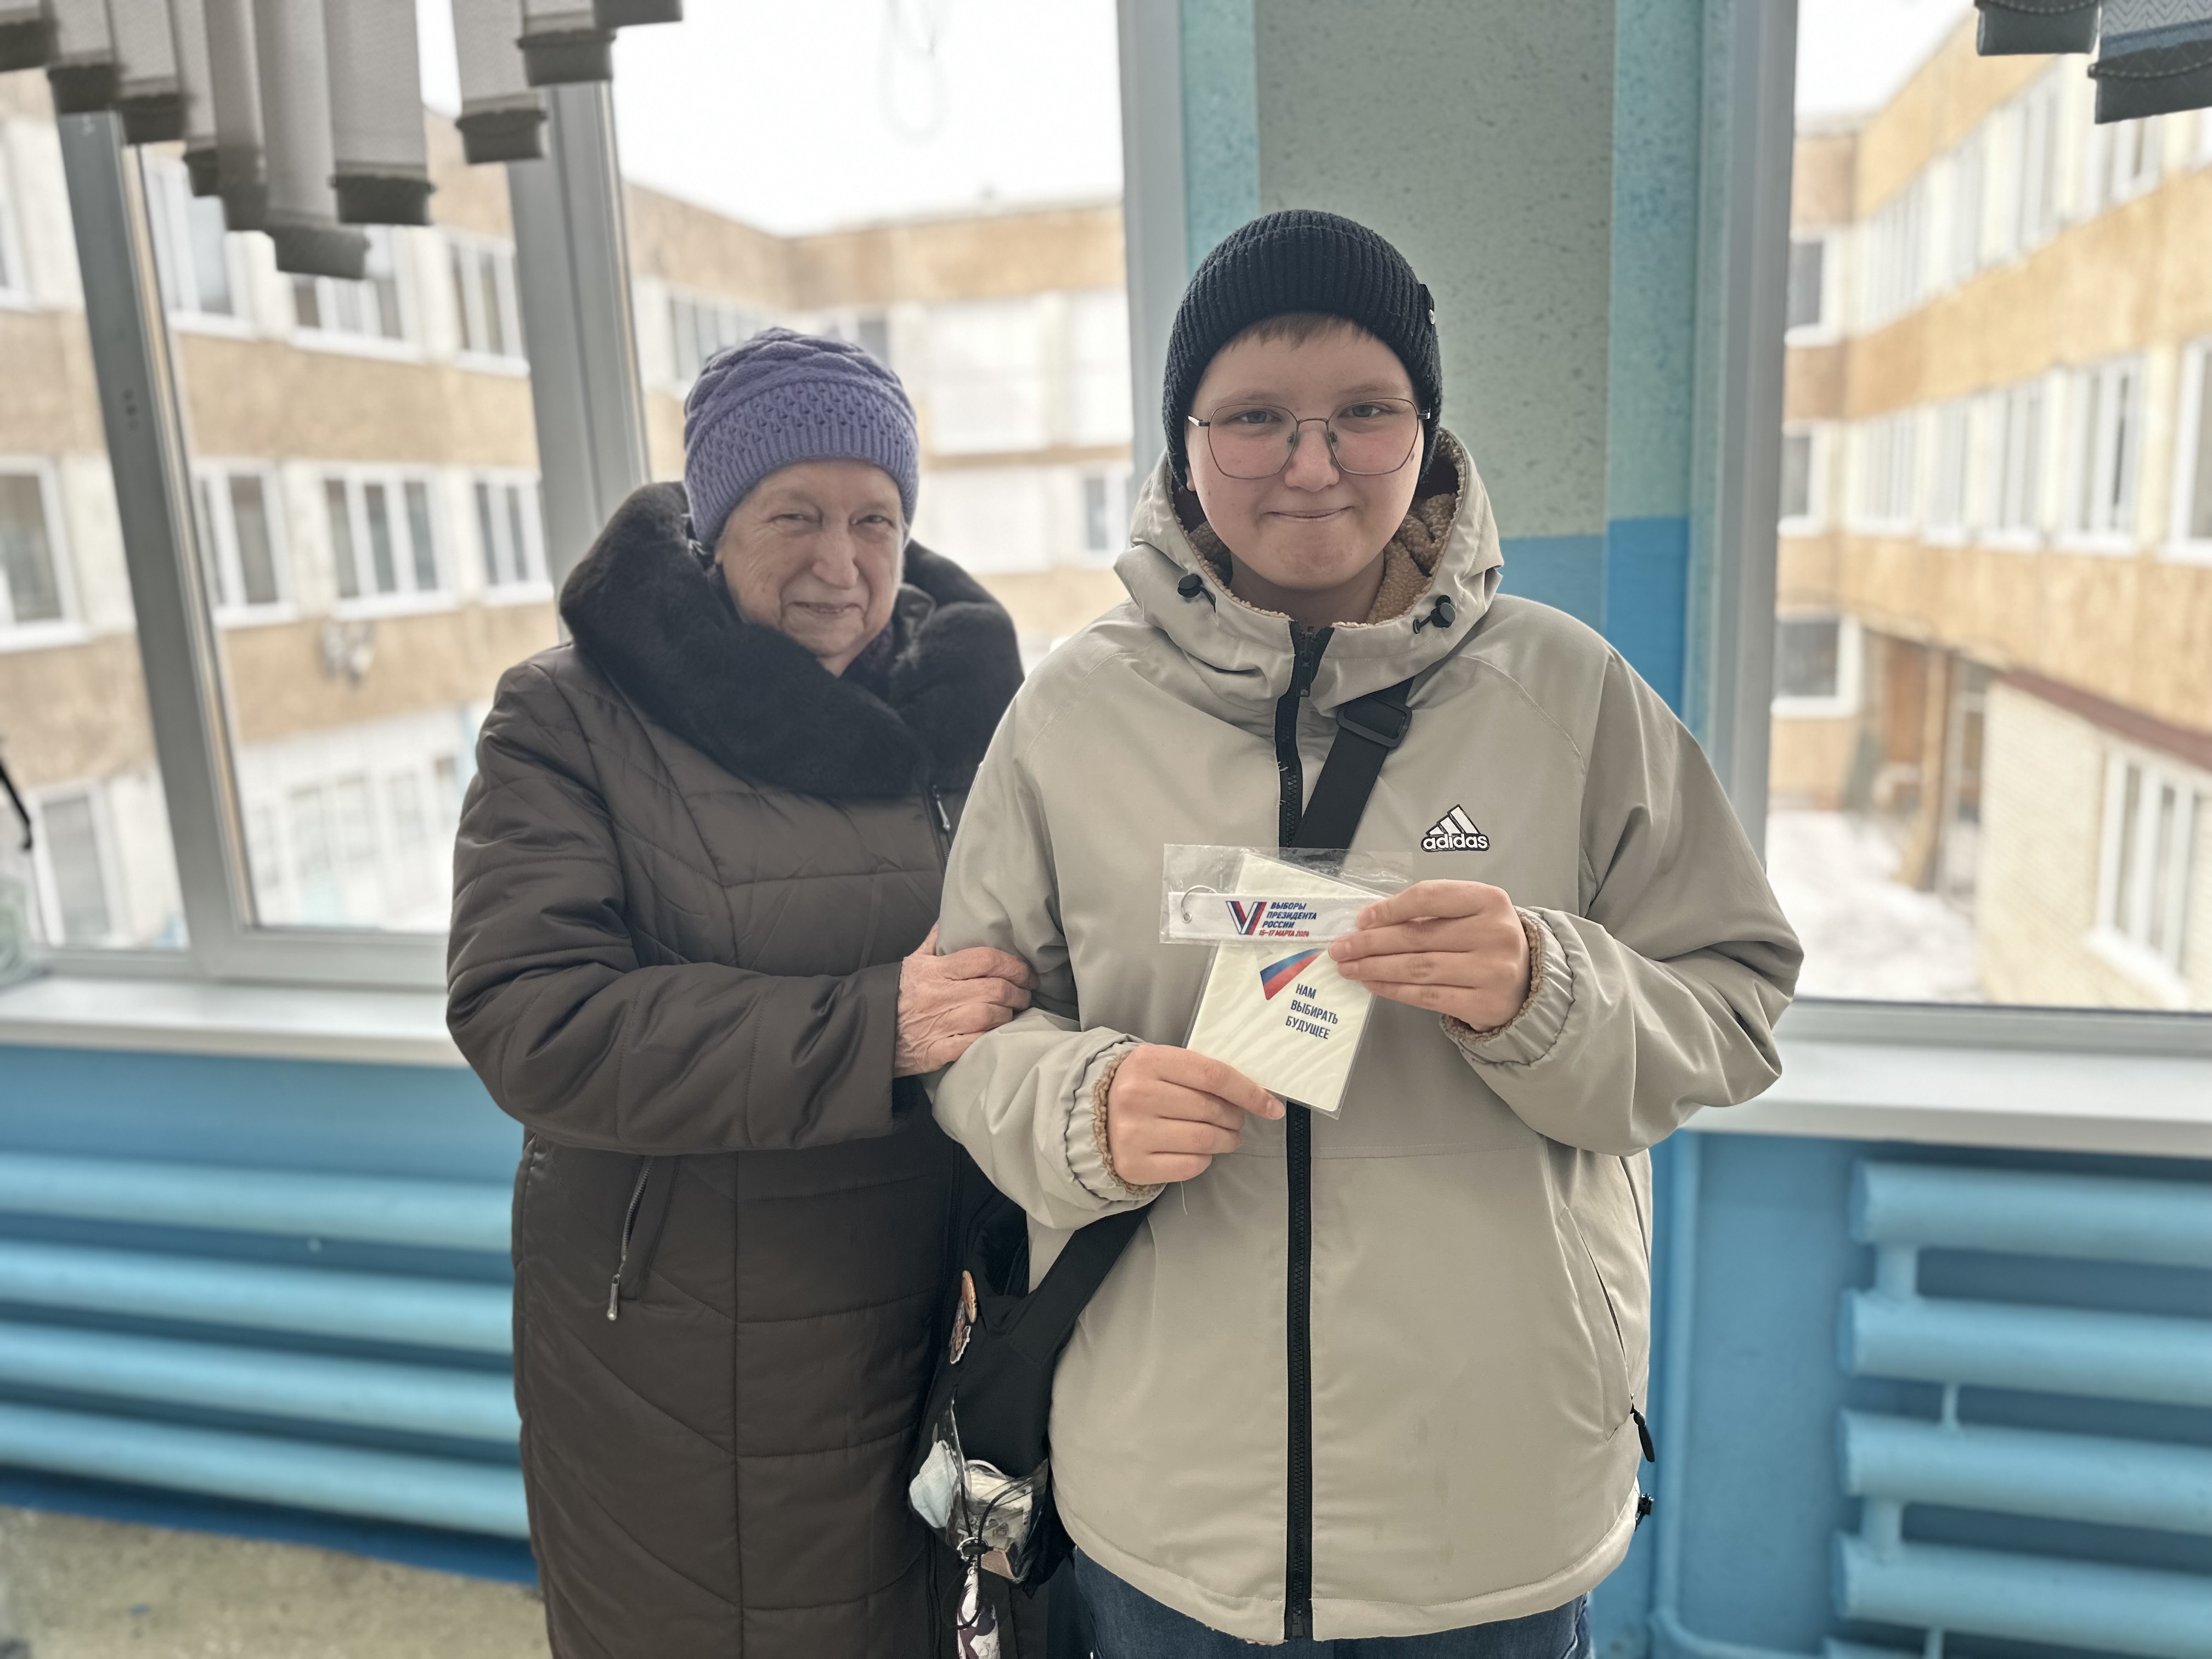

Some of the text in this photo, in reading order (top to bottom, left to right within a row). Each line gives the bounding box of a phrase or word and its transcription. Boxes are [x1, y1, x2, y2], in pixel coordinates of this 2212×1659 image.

[1423, 833, 1488, 849] adidas
[1270, 902, 1306, 910] ВЫБОРЫ
[1266, 911, 1317, 920] ПРЕЗИДЕНТА
[1295, 983, 1317, 999] НАМ
[1290, 1000, 1338, 1024] ВЫБИРАТЬ
[1285, 1015, 1330, 1040] БУДУЩЕЕ
